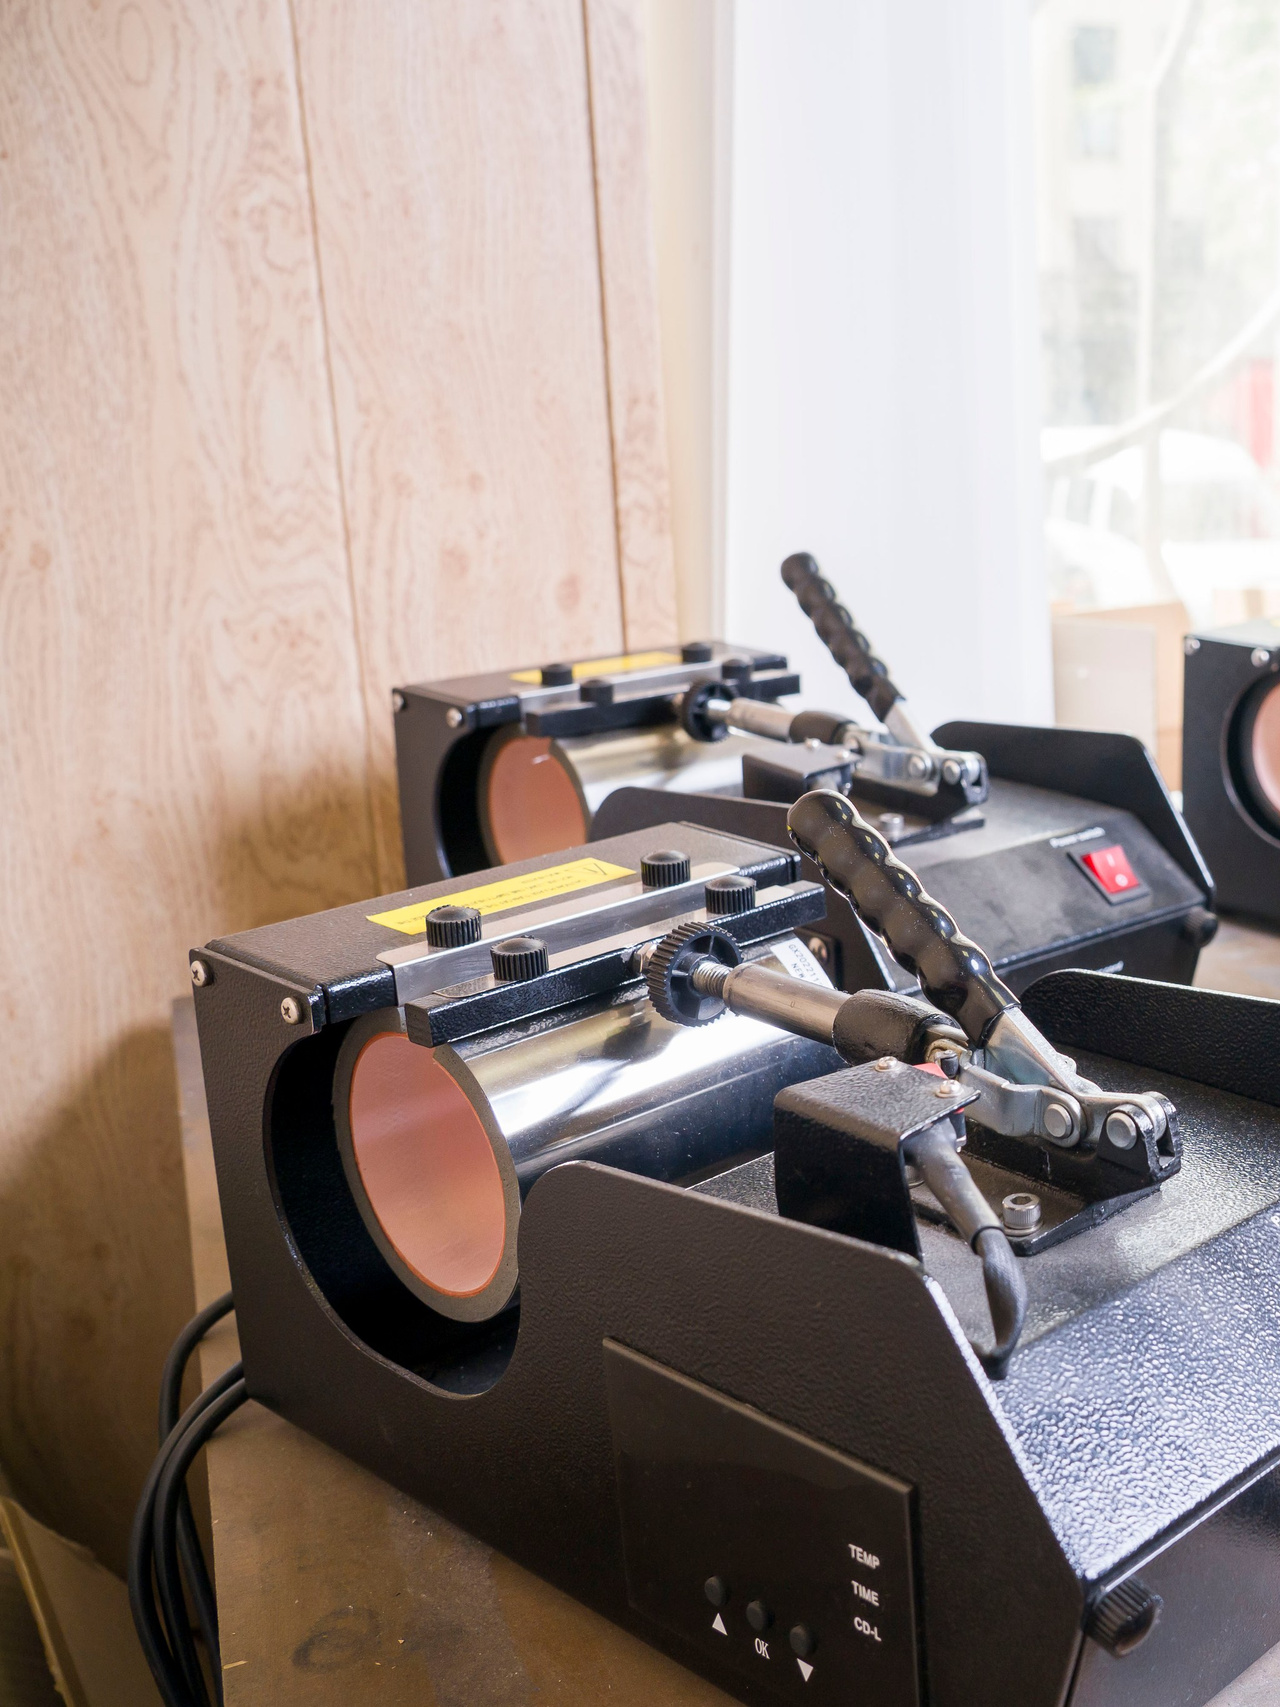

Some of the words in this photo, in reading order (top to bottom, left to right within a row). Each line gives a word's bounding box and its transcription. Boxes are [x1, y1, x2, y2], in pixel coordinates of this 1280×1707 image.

[847, 1543, 881, 1570] TEMP
[851, 1580, 880, 1607] TIME
[853, 1616, 882, 1642] CD-L
[754, 1637, 771, 1660] OK
